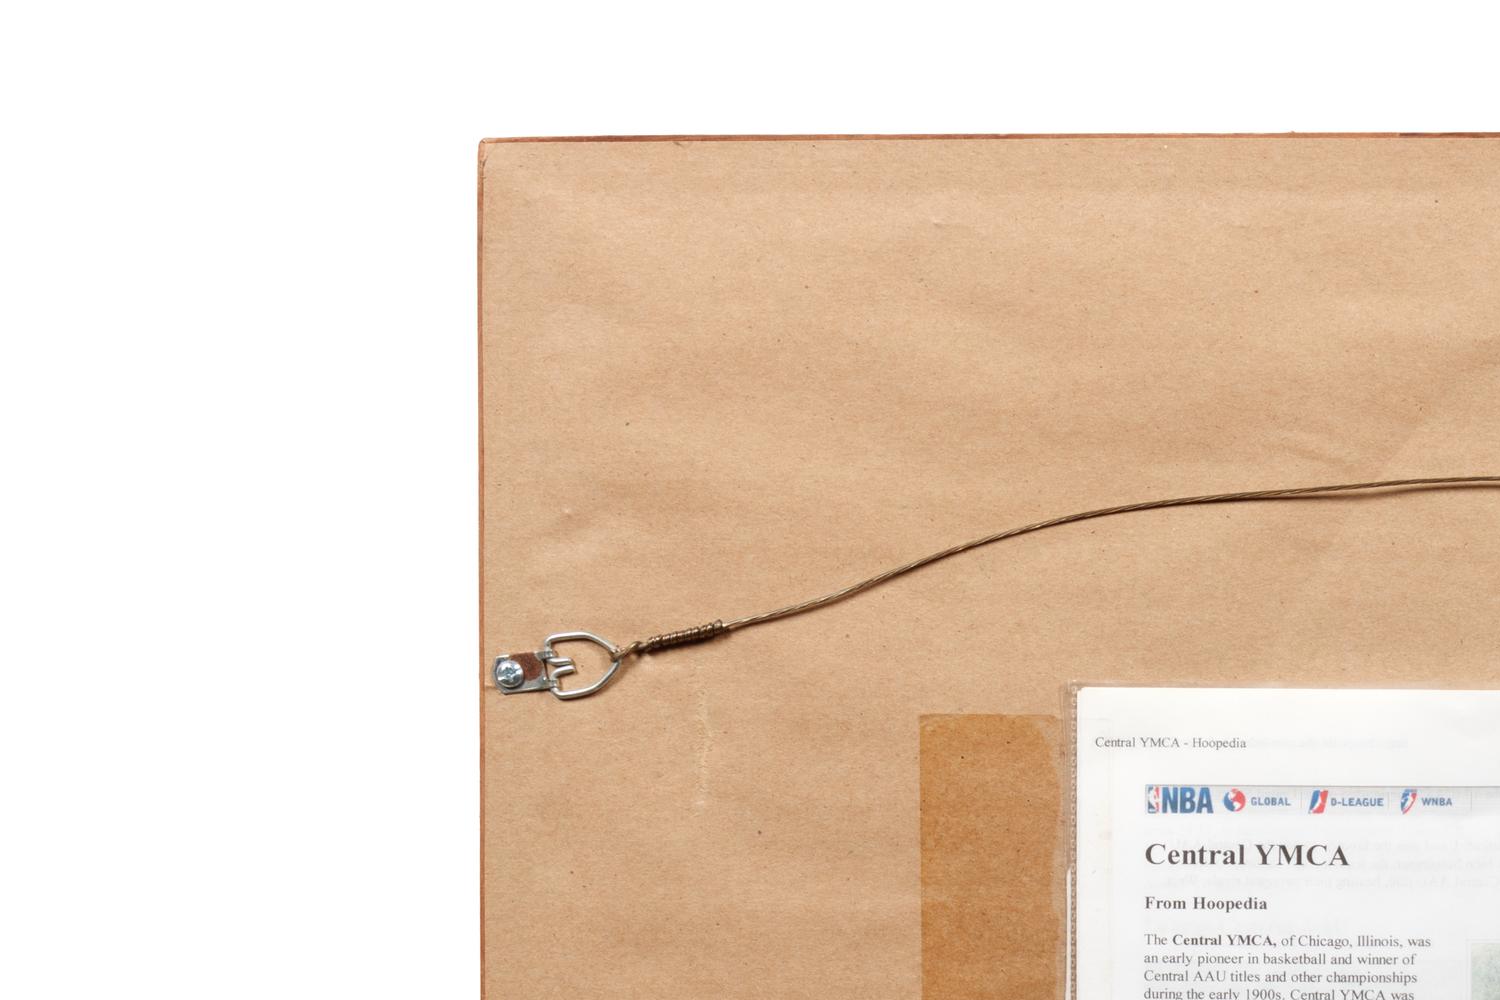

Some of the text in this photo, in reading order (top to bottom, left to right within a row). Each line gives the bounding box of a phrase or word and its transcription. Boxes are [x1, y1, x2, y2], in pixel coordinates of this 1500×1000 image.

[1095, 737, 1136, 748] Central
[1140, 737, 1180, 748] YMCA
[1192, 737, 1247, 751] Hoopedia
[1161, 786, 1214, 814] NBA
[1250, 796, 1292, 807] GLOBAL
[1330, 797, 1384, 807] D-LEAGUE
[1421, 797, 1453, 807] WNBA
[1145, 843, 1350, 866] Central YMCA
[1145, 896, 1267, 913] From Hoopedia
[1144, 933, 1431, 950] The Central YMCA, of Chicago, Illinois, was
[1144, 969, 1418, 986] Central AAU titles and other championships
